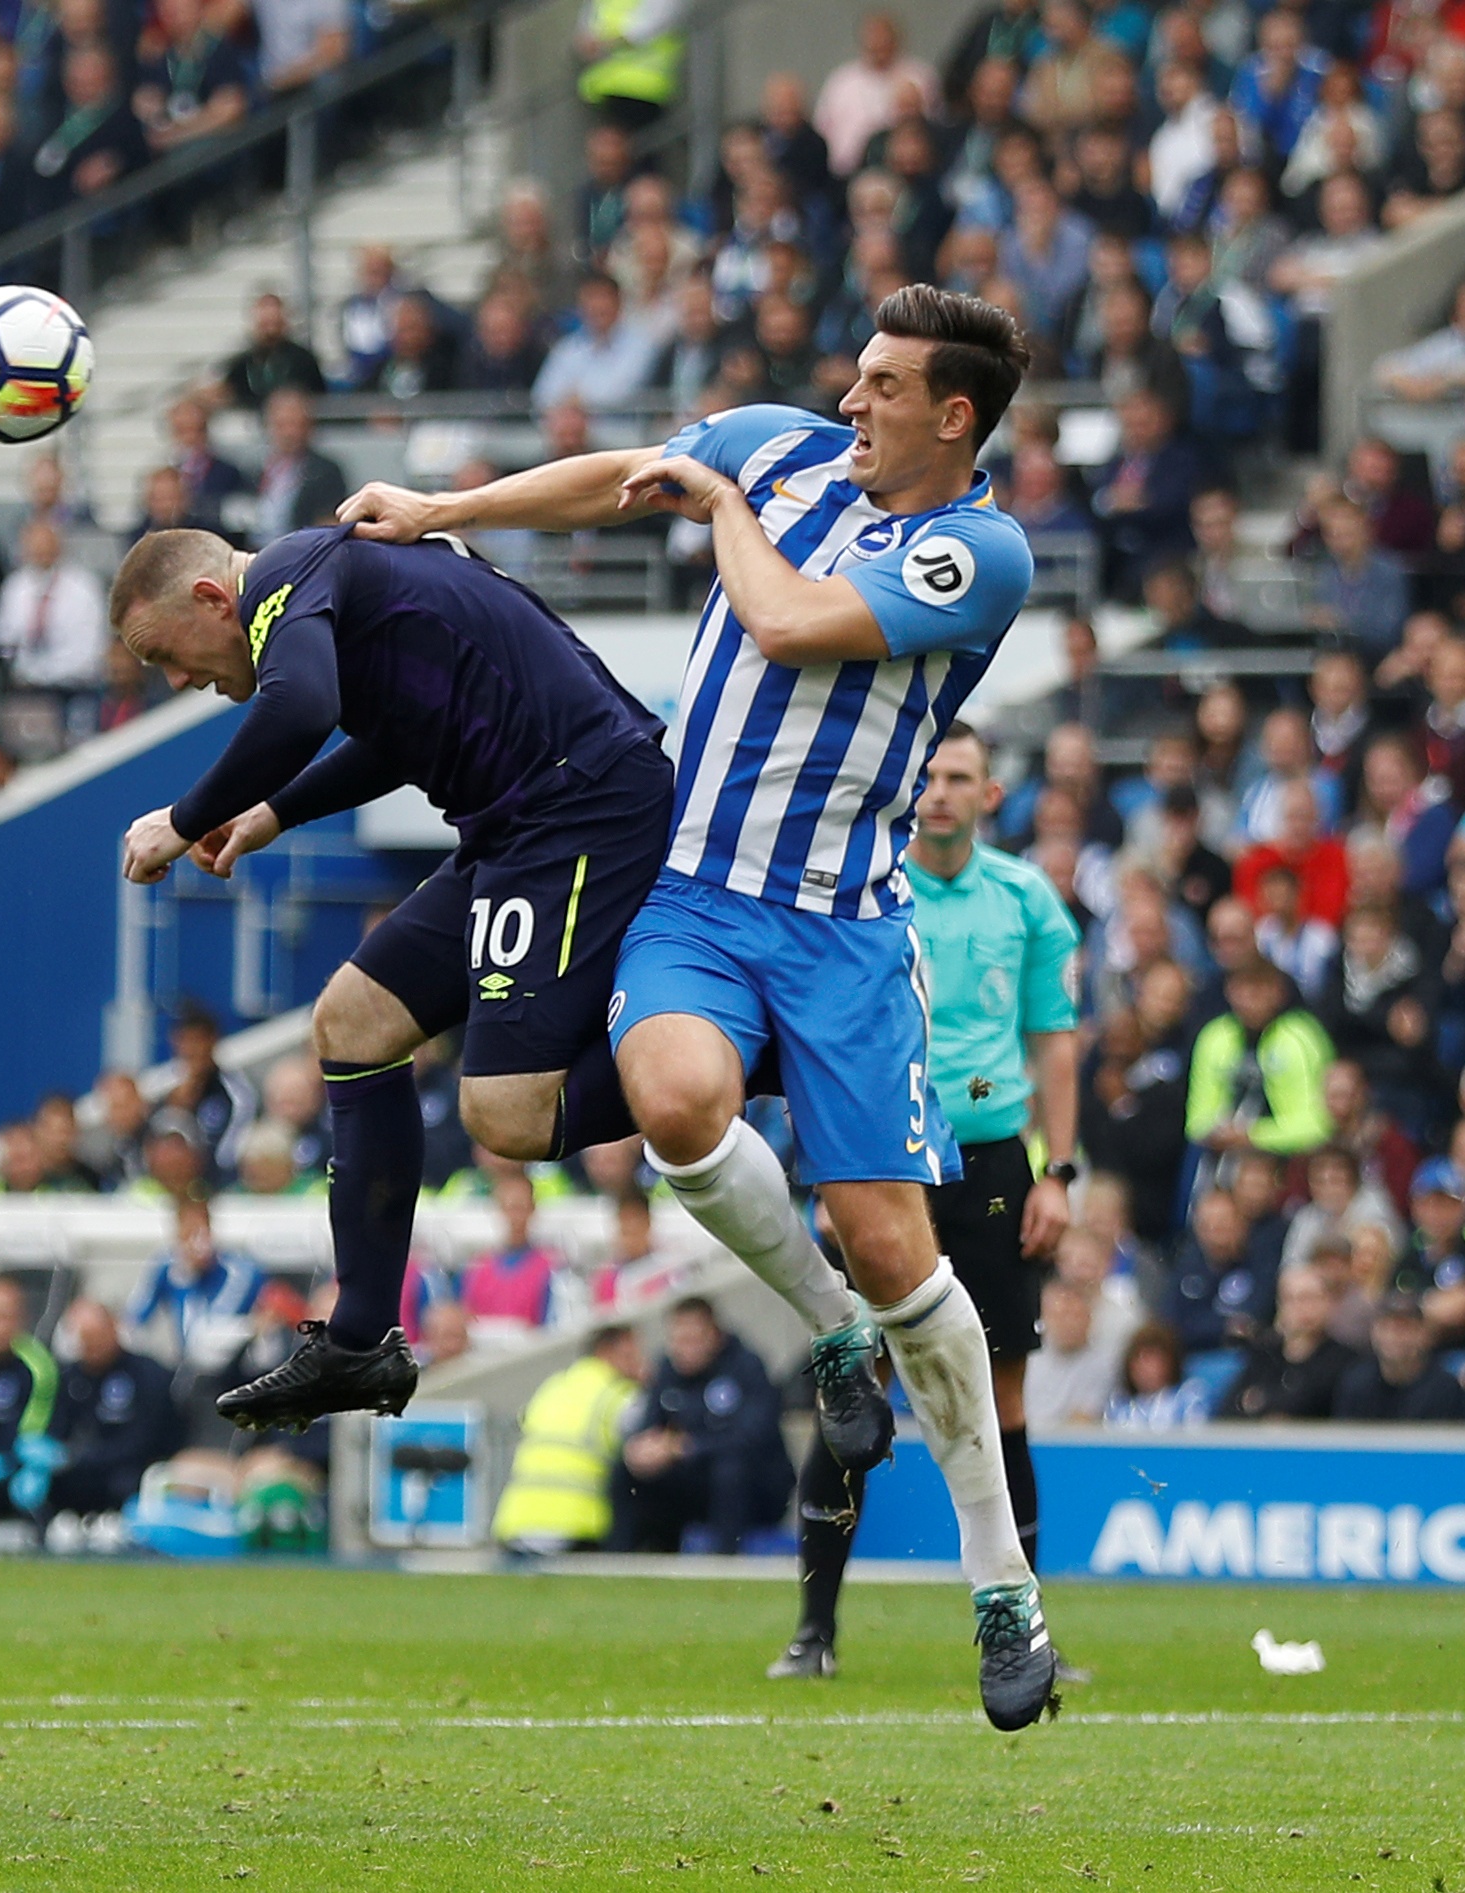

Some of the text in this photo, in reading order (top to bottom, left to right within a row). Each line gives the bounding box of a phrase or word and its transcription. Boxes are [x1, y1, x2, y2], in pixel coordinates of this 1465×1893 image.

[912, 552, 963, 593] JD
[470, 897, 534, 970] 10
[909, 1062, 925, 1136] 5
[1089, 1499, 1465, 1583] AMERIC
